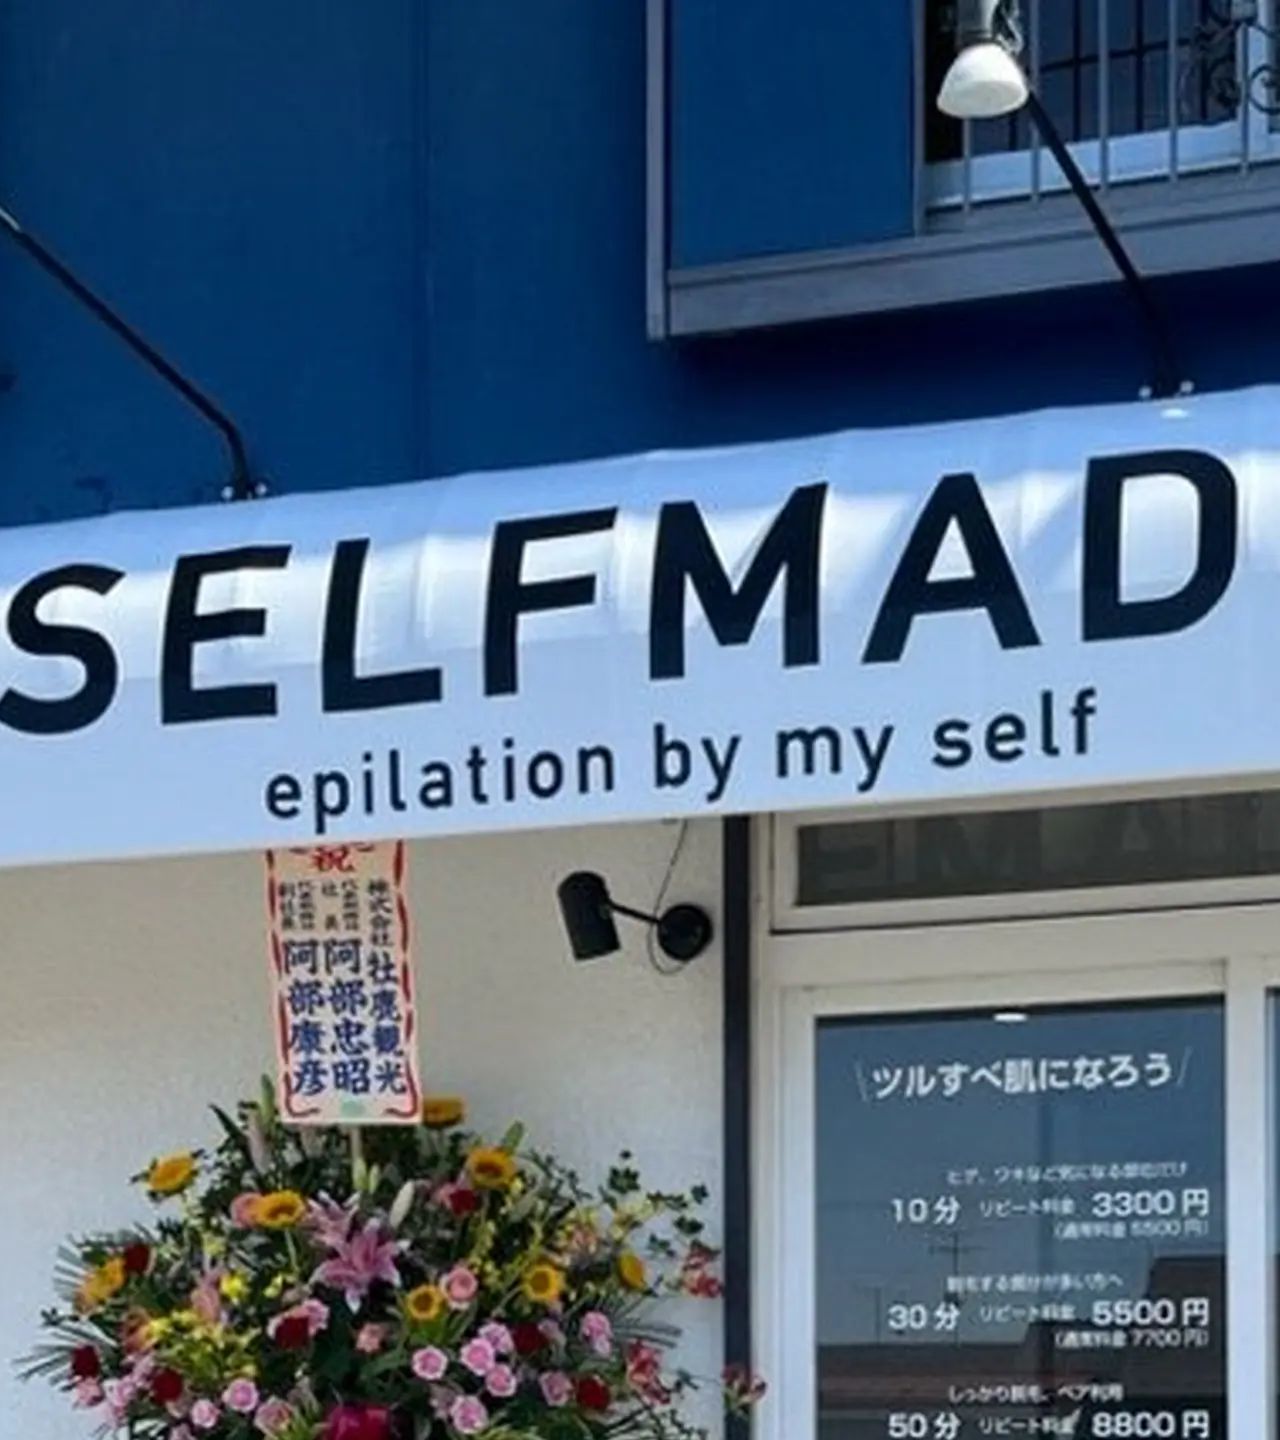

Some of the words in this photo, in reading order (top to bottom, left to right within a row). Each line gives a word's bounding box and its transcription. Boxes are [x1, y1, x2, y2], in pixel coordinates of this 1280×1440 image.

[263, 738, 615, 832] epilation
[654, 722, 741, 802] by
[775, 724, 894, 791] my
[931, 687, 1098, 768] self
[871, 1053, 1173, 1099] ツルすべ肌になろう
